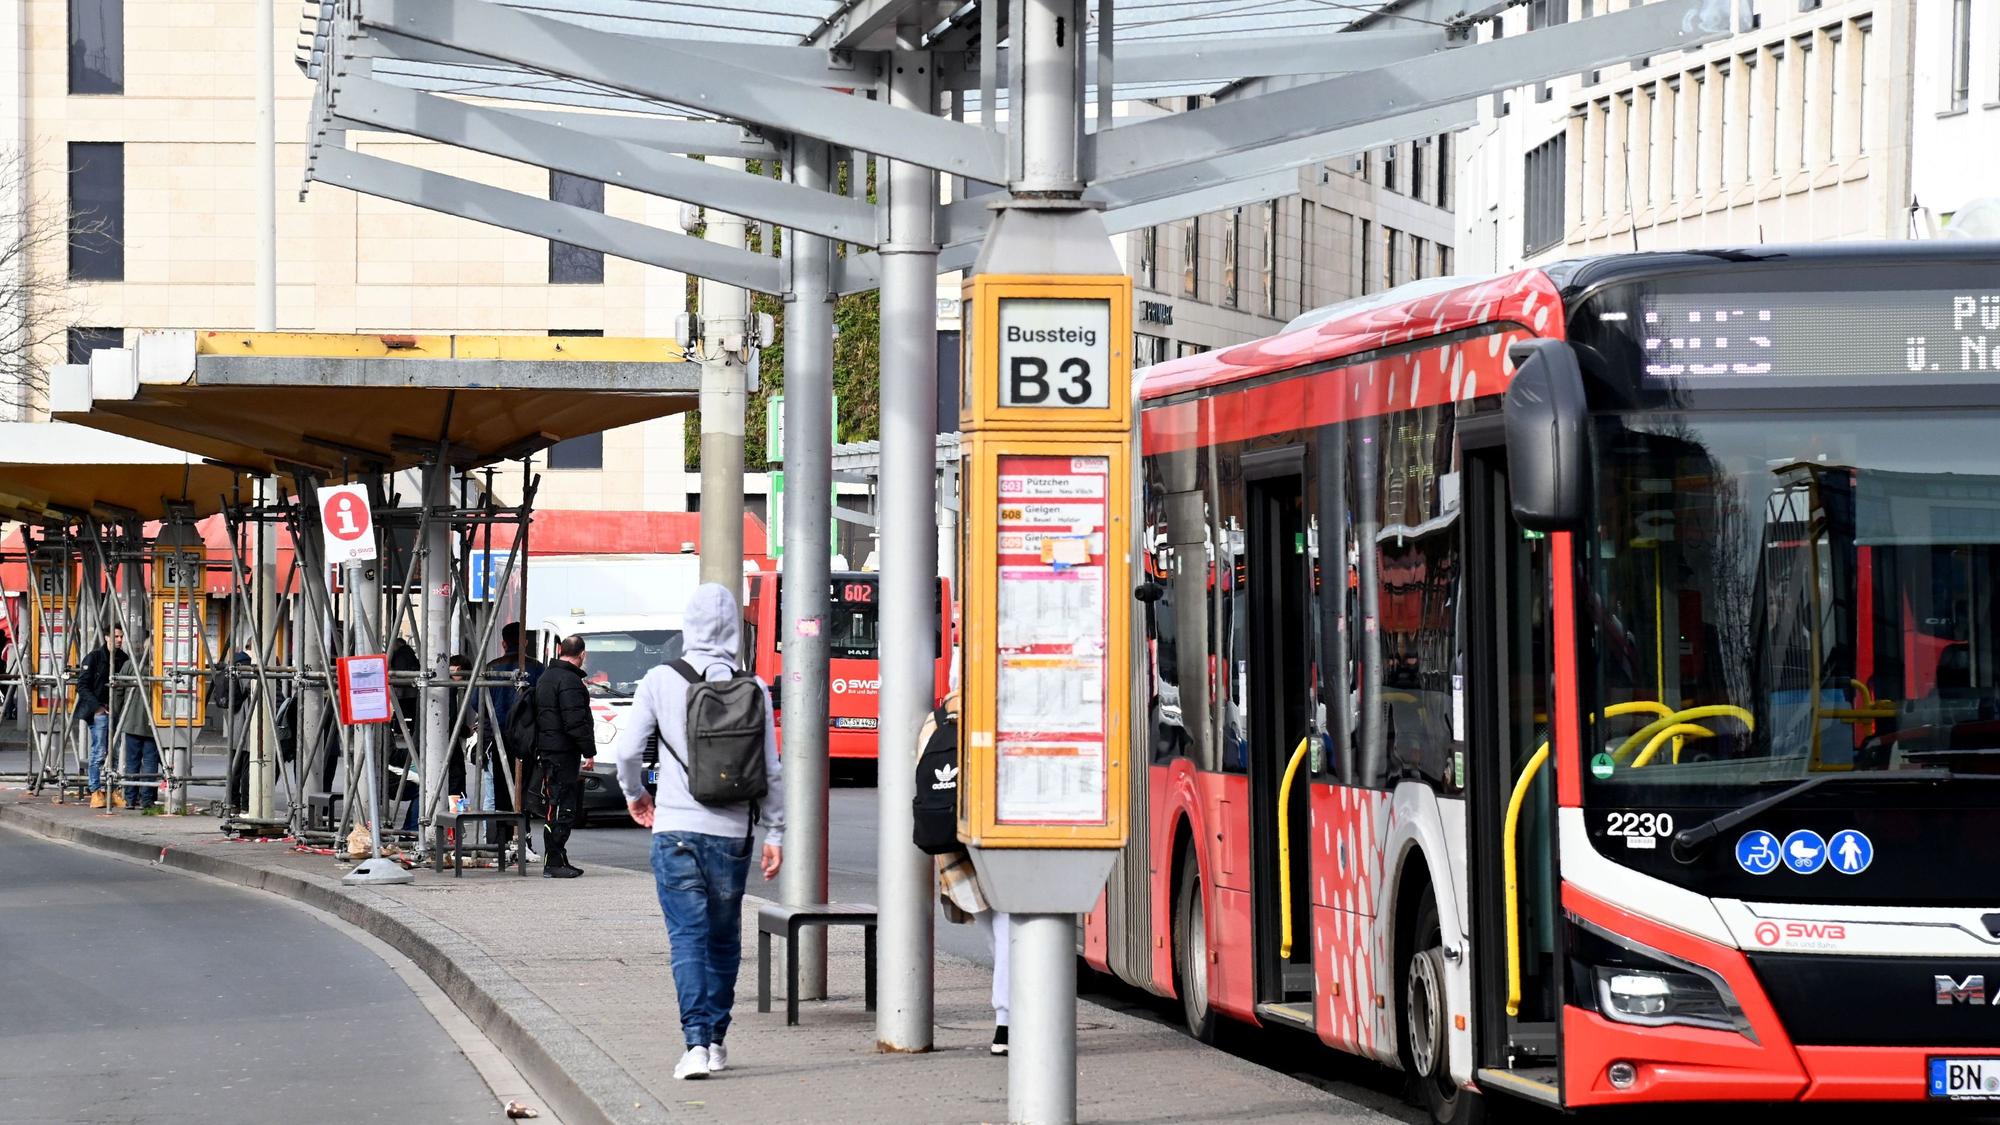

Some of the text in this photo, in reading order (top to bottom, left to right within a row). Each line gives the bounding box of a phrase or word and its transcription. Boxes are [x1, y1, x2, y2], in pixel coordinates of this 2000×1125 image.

[1007, 326, 1096, 346] Bussteig
[1906, 336, 1940, 371] ü.
[1010, 357, 1092, 404] B3
[1027, 478, 1069, 486] Pützchen
[1001, 505, 1061, 520] 608 Gielgen
[844, 584, 872, 602] 602
[848, 679, 881, 689] SWB
[932, 781, 957, 790] adidas
[1606, 812, 1674, 837] 2230
[1786, 923, 1846, 940] SWB
[1934, 975, 2000, 1006] M
[1949, 1064, 1982, 1091] BN
